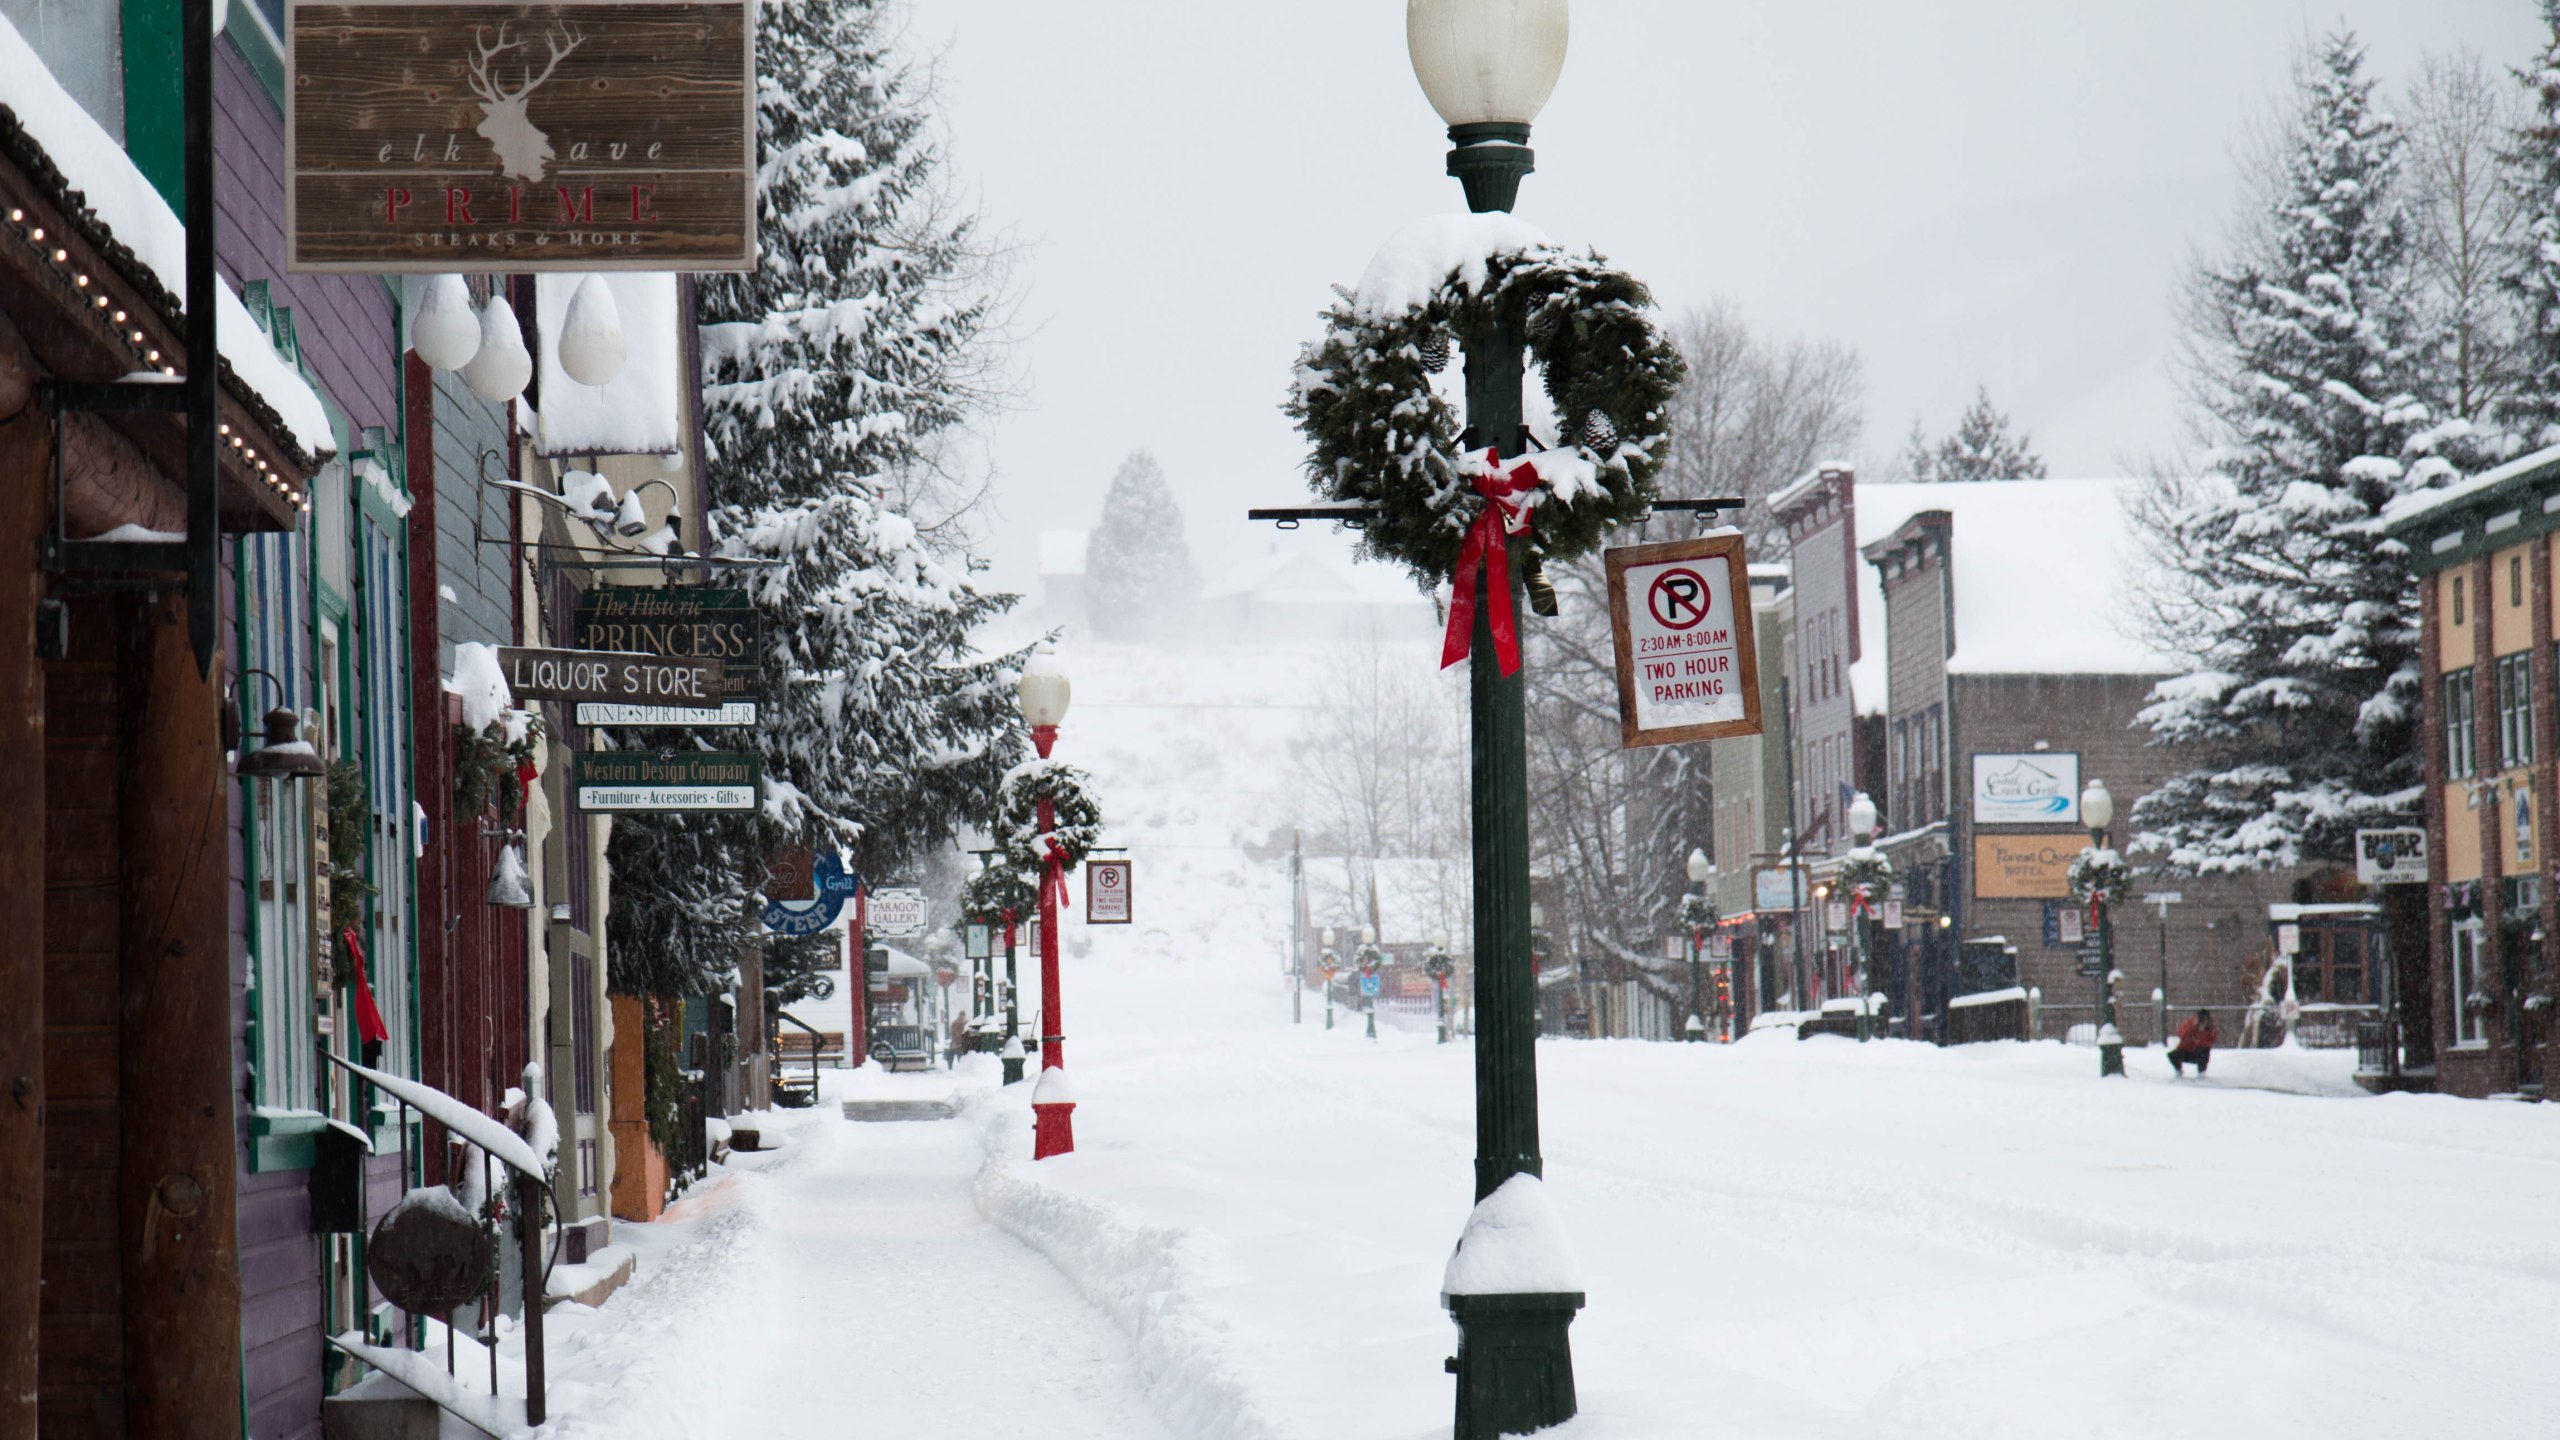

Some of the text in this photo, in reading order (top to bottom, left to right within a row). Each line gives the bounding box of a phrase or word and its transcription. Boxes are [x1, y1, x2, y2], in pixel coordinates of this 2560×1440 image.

[378, 134, 662, 162] elk ave
[386, 184, 658, 225] PRIME
[415, 232, 641, 246] STEAKS & MORE
[595, 592, 628, 616] The
[588, 623, 744, 657] PRINCESS
[514, 658, 708, 698] LIQUOR STORE
[1644, 656, 1730, 681] TWO HOUR
[1654, 678, 1725, 702] PARKING
[580, 704, 629, 722] WINE
[583, 760, 751, 784] Western Design Company
[592, 790, 740, 805] Furniture Accessories Gifts
[825, 875, 853, 891] Grill
[765, 902, 828, 932] STEEP
[873, 901, 920, 913] PARAGON
[874, 912, 919, 924] GALLERY
